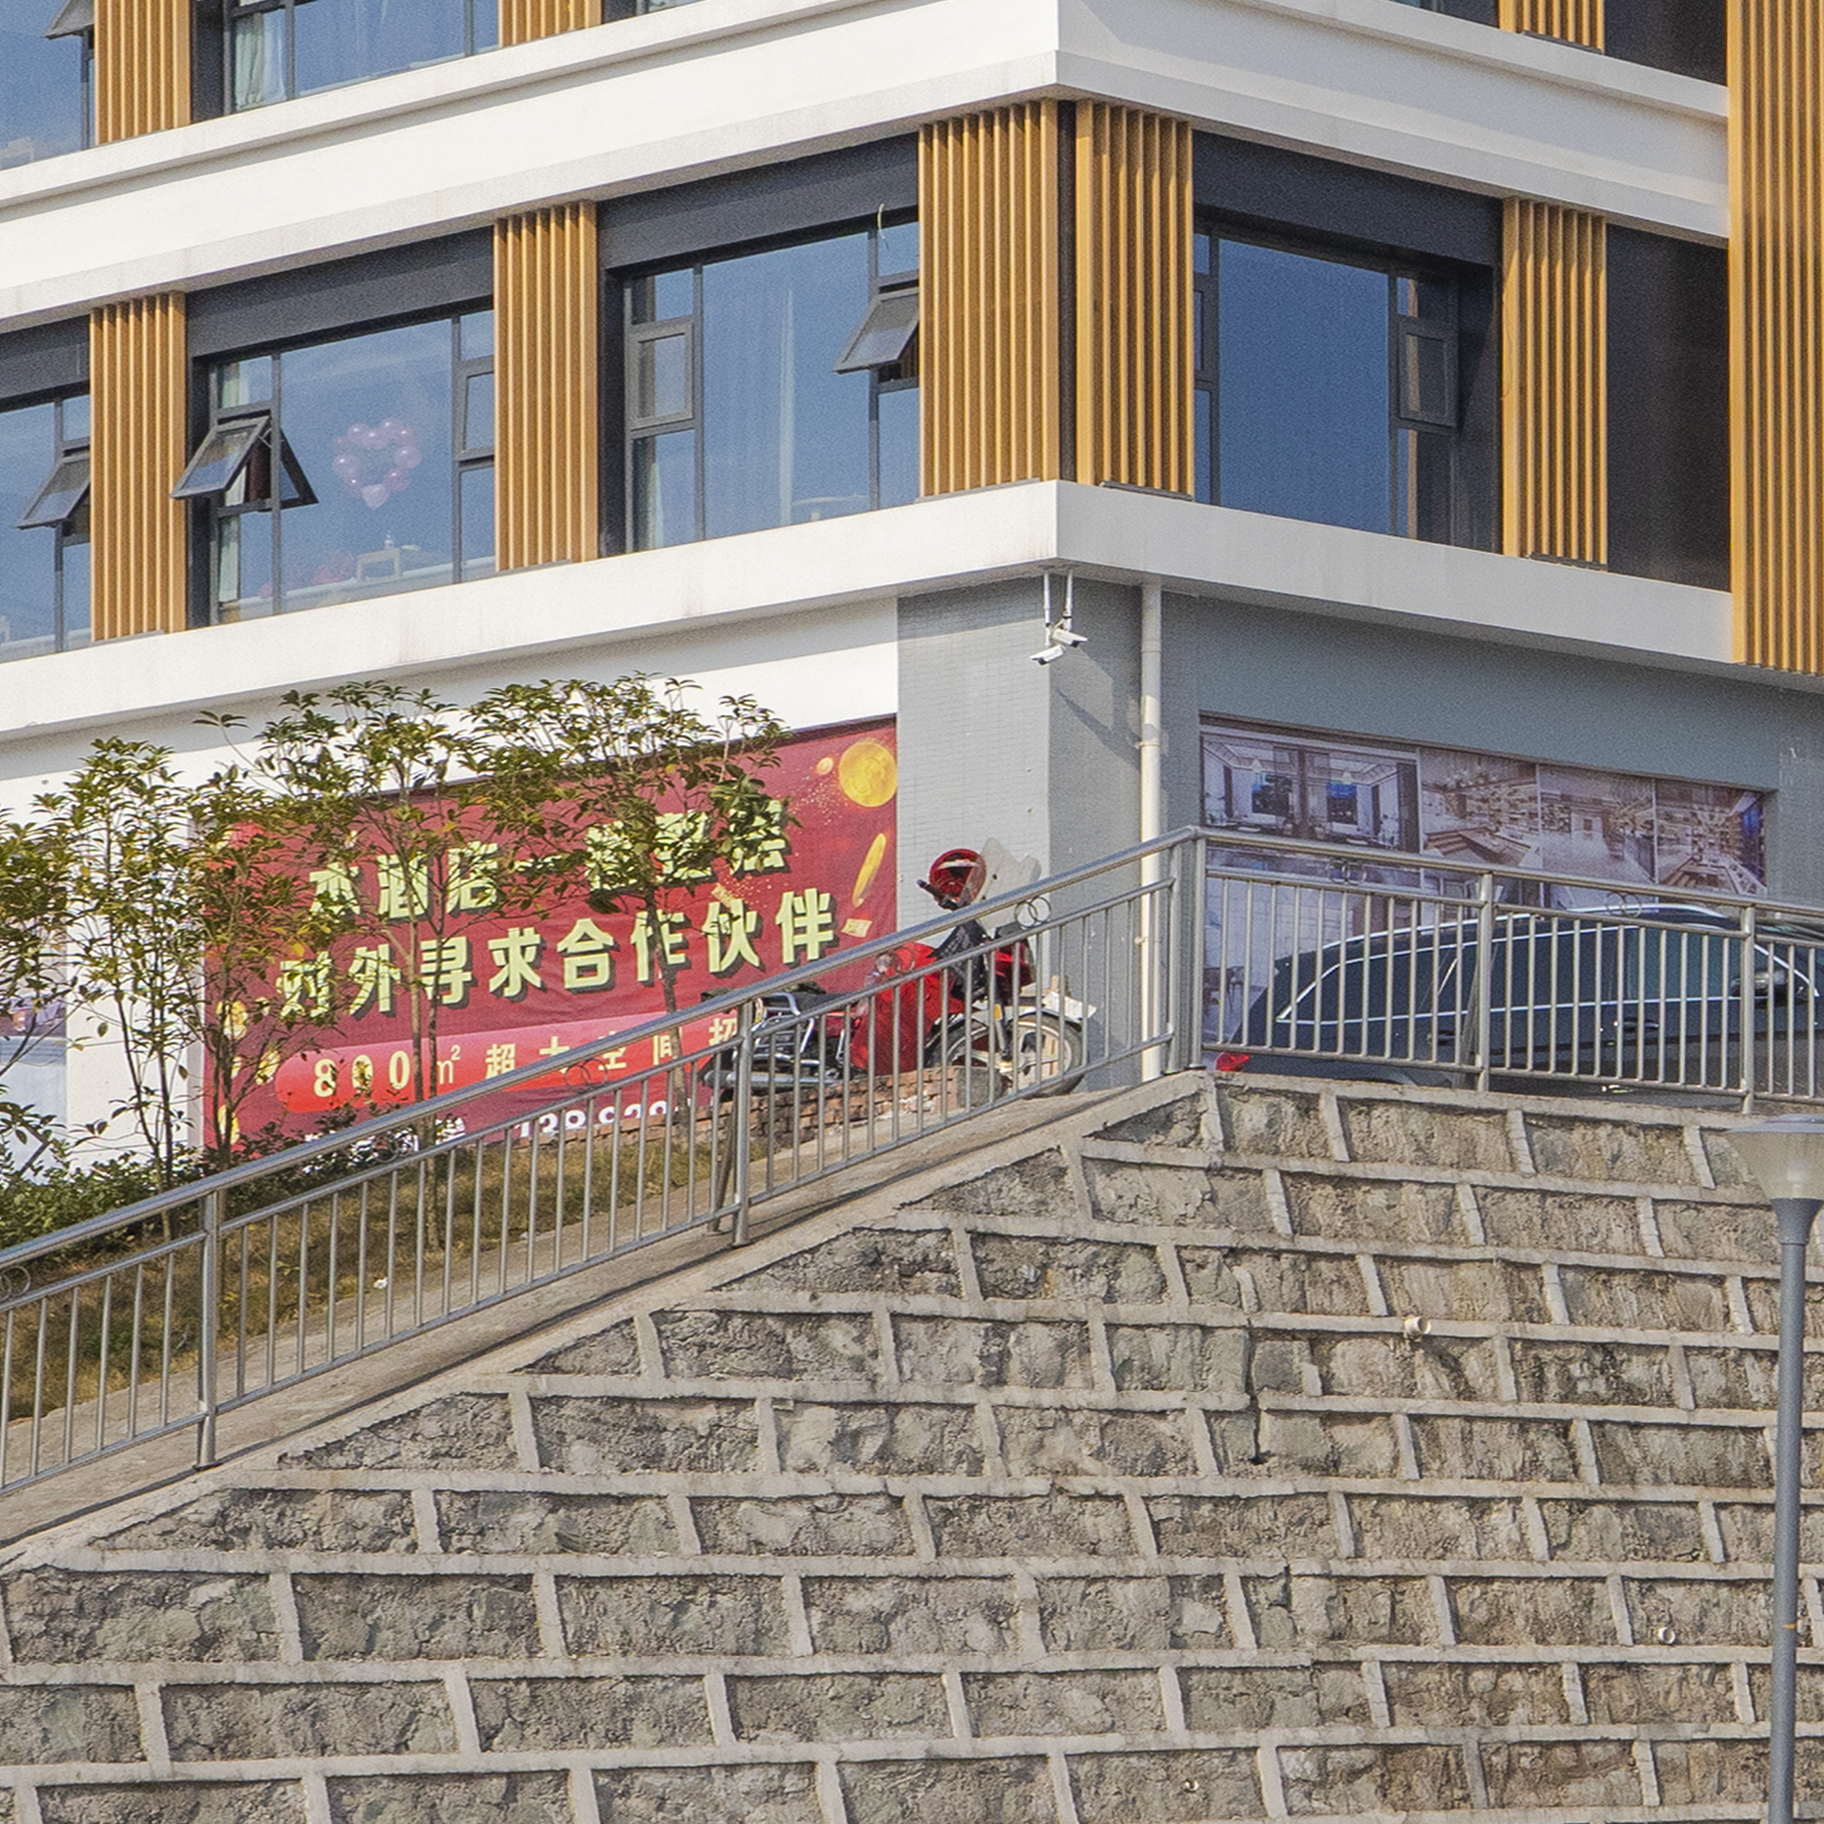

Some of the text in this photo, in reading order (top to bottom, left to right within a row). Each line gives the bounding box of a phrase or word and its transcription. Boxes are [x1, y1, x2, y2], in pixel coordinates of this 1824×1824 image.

[276, 888, 835, 1018] 对外寻求合作伙伴
